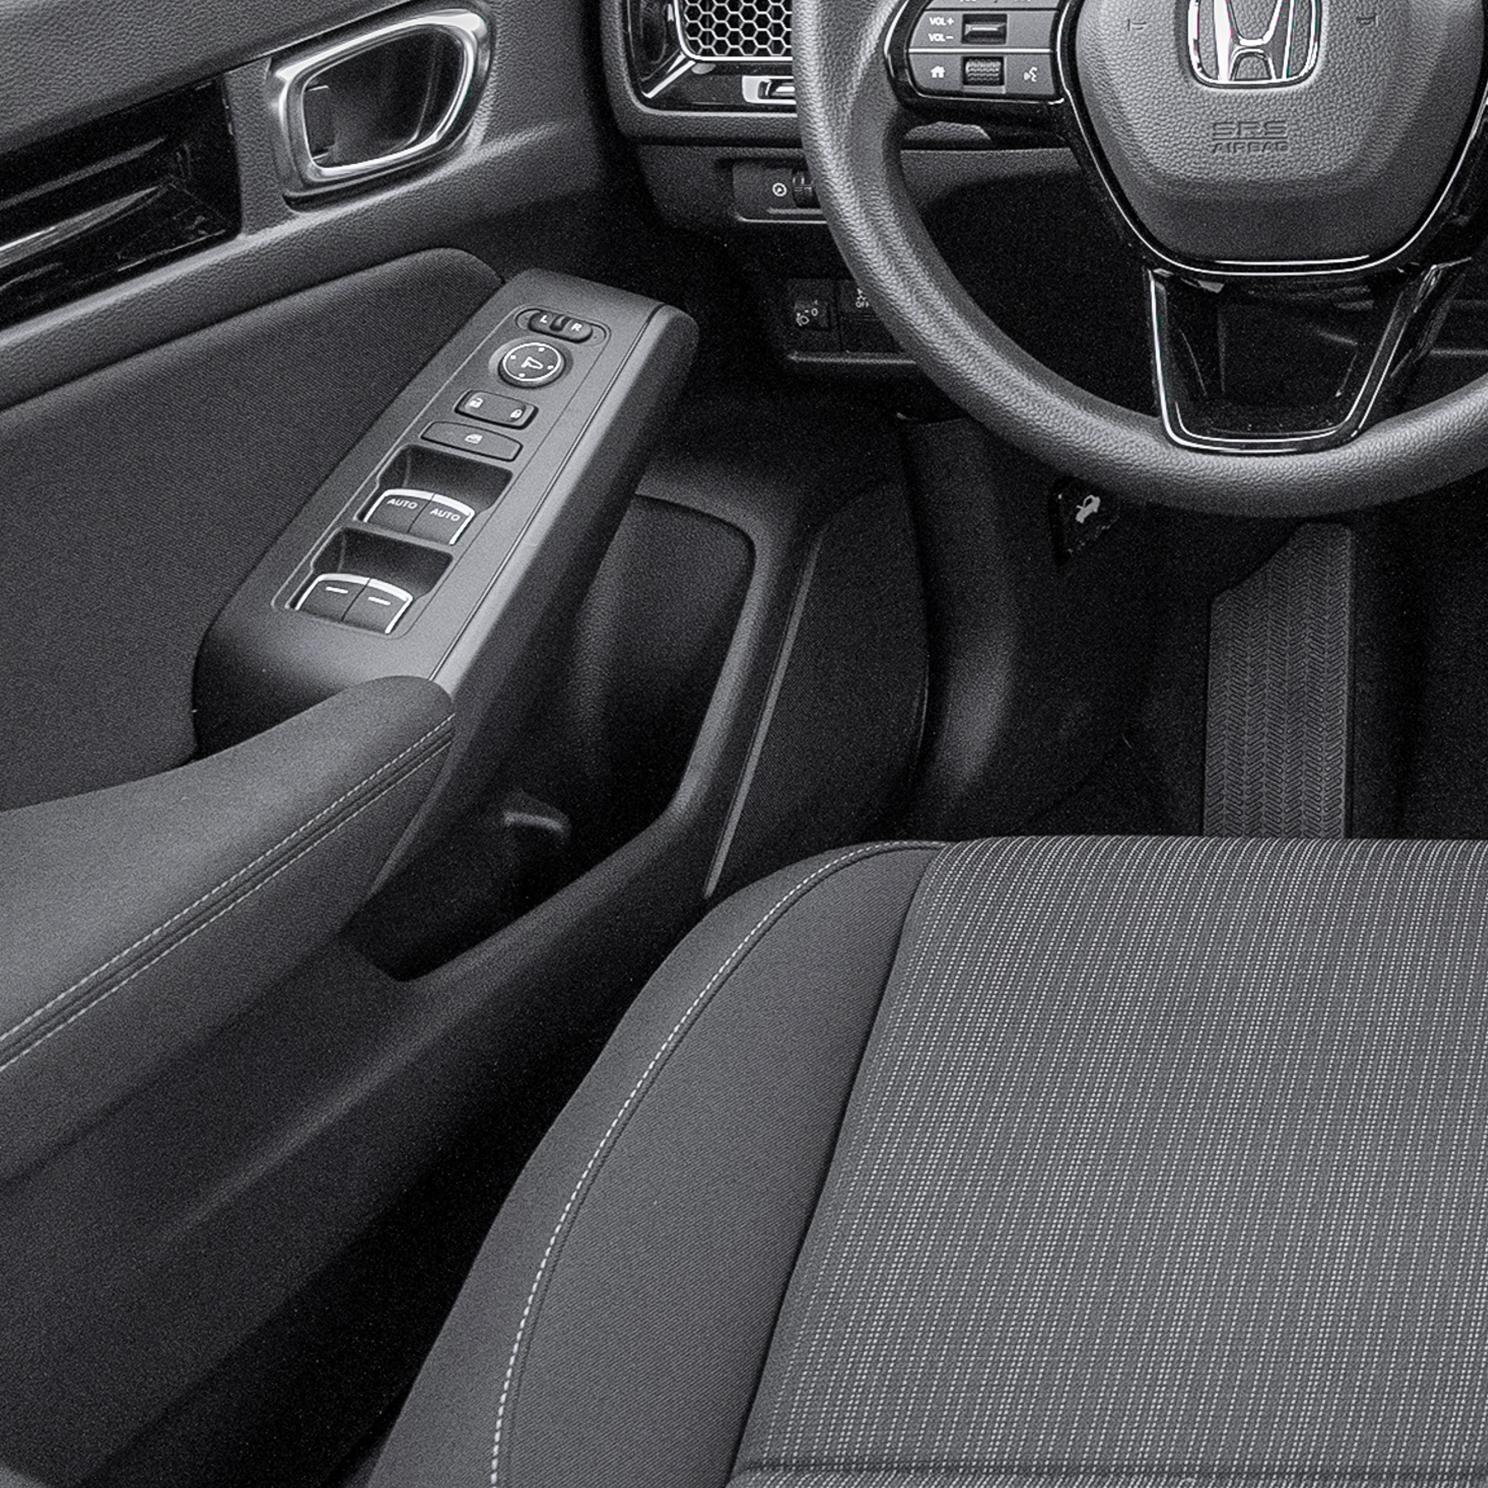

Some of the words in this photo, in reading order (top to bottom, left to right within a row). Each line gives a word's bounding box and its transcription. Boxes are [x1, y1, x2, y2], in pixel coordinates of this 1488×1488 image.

[1212, 120, 1288, 136] SRS
[540, 315, 548, 323] L
[571, 323, 582, 331] R
[387, 497, 418, 509] AUTO
[430, 508, 460, 521] AUTO
